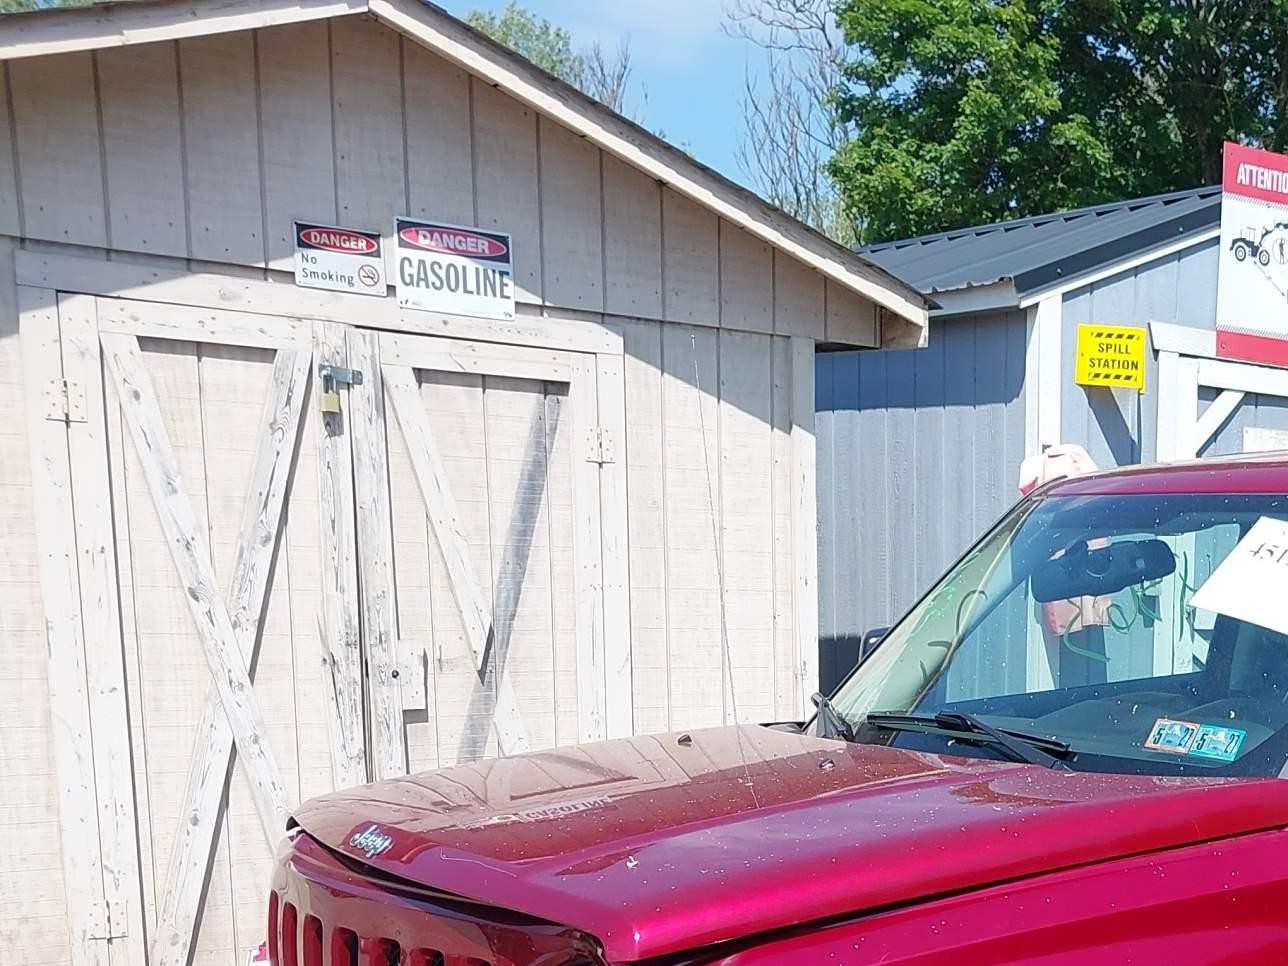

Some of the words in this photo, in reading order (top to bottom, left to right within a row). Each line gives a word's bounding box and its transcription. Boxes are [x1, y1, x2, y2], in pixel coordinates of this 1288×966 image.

[310, 231, 367, 251] DANGER
[418, 229, 490, 255] DANGER
[301, 253, 318, 265] No
[302, 268, 355, 288] Smoking
[399, 256, 512, 301] GASOLINE
[1097, 342, 1132, 355] SPILL
[1088, 357, 1139, 371] STATION
[1152, 727, 1166, 745] 5
[1196, 733, 1208, 751] 5
[1223, 733, 1241, 754] 27
[349, 824, 393, 858] Jeep
